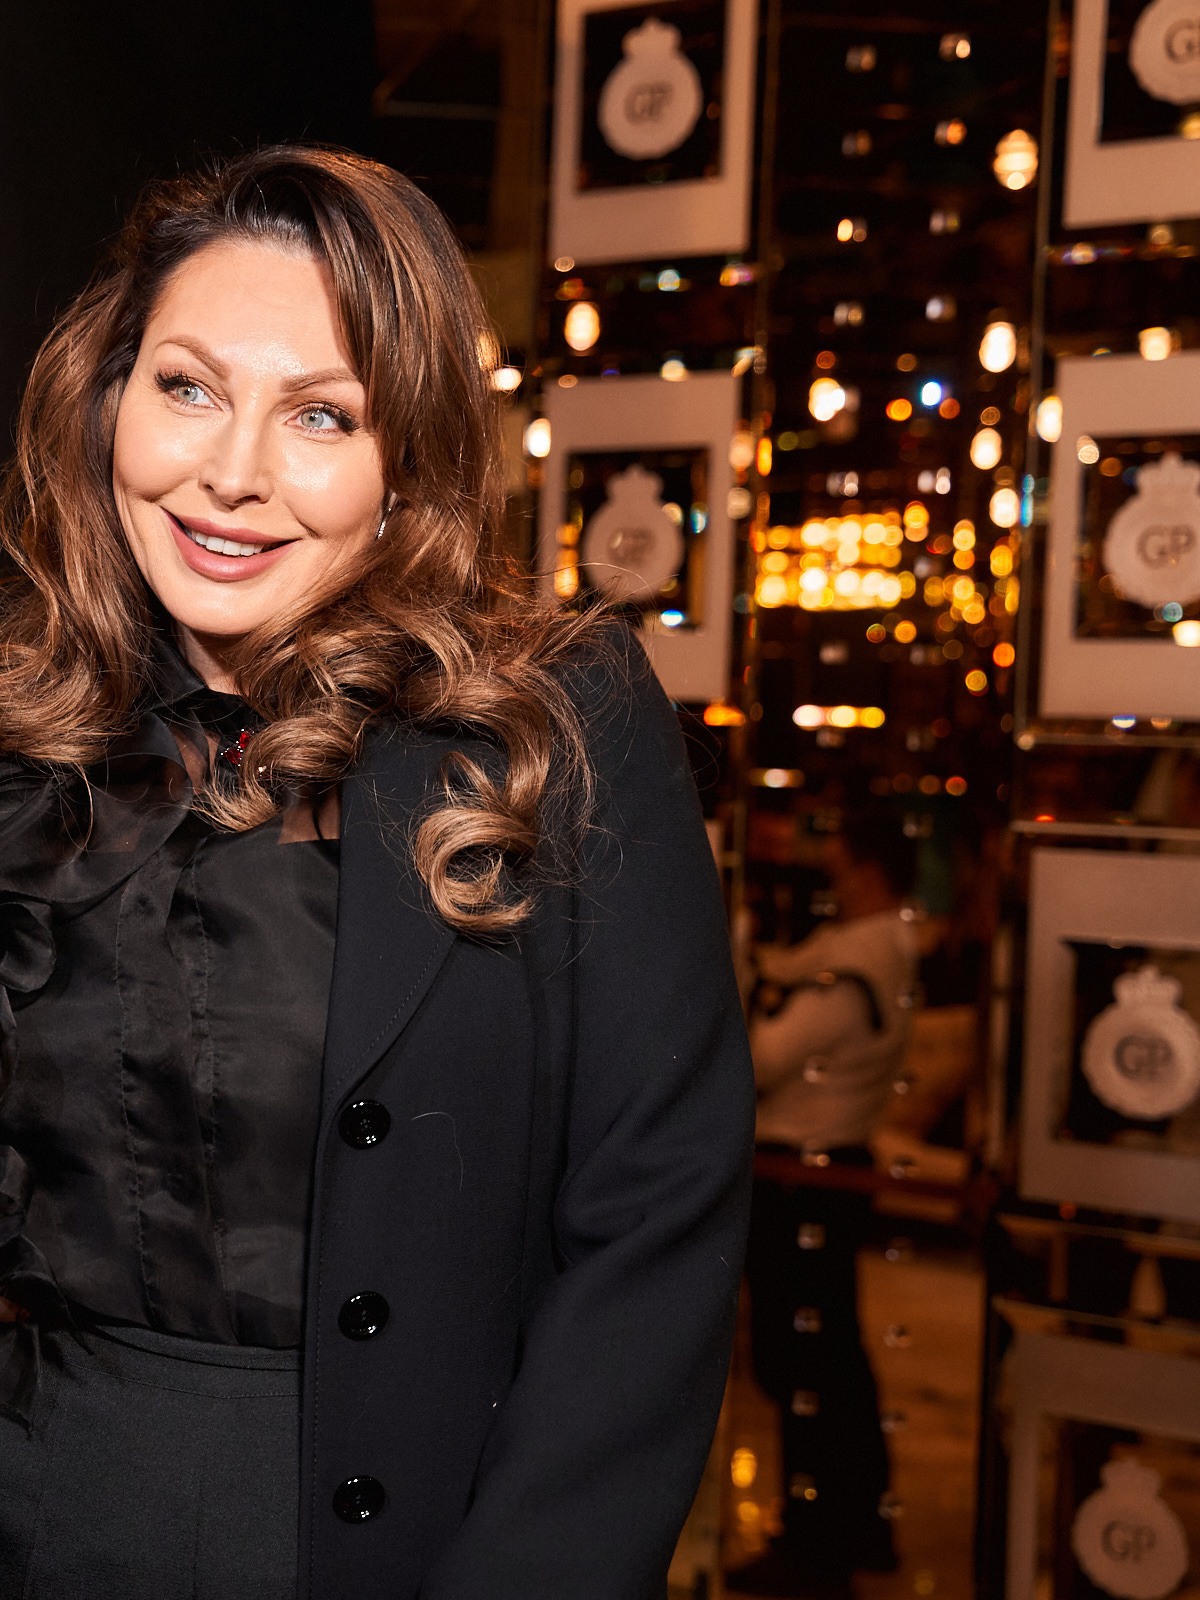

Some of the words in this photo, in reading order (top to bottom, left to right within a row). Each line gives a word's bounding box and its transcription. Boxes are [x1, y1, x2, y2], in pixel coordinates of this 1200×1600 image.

[1165, 19, 1200, 64] G
[625, 81, 676, 125] GP
[1138, 524, 1197, 569] GP
[1114, 1033, 1175, 1083] GP
[1102, 1520, 1157, 1564] GP
